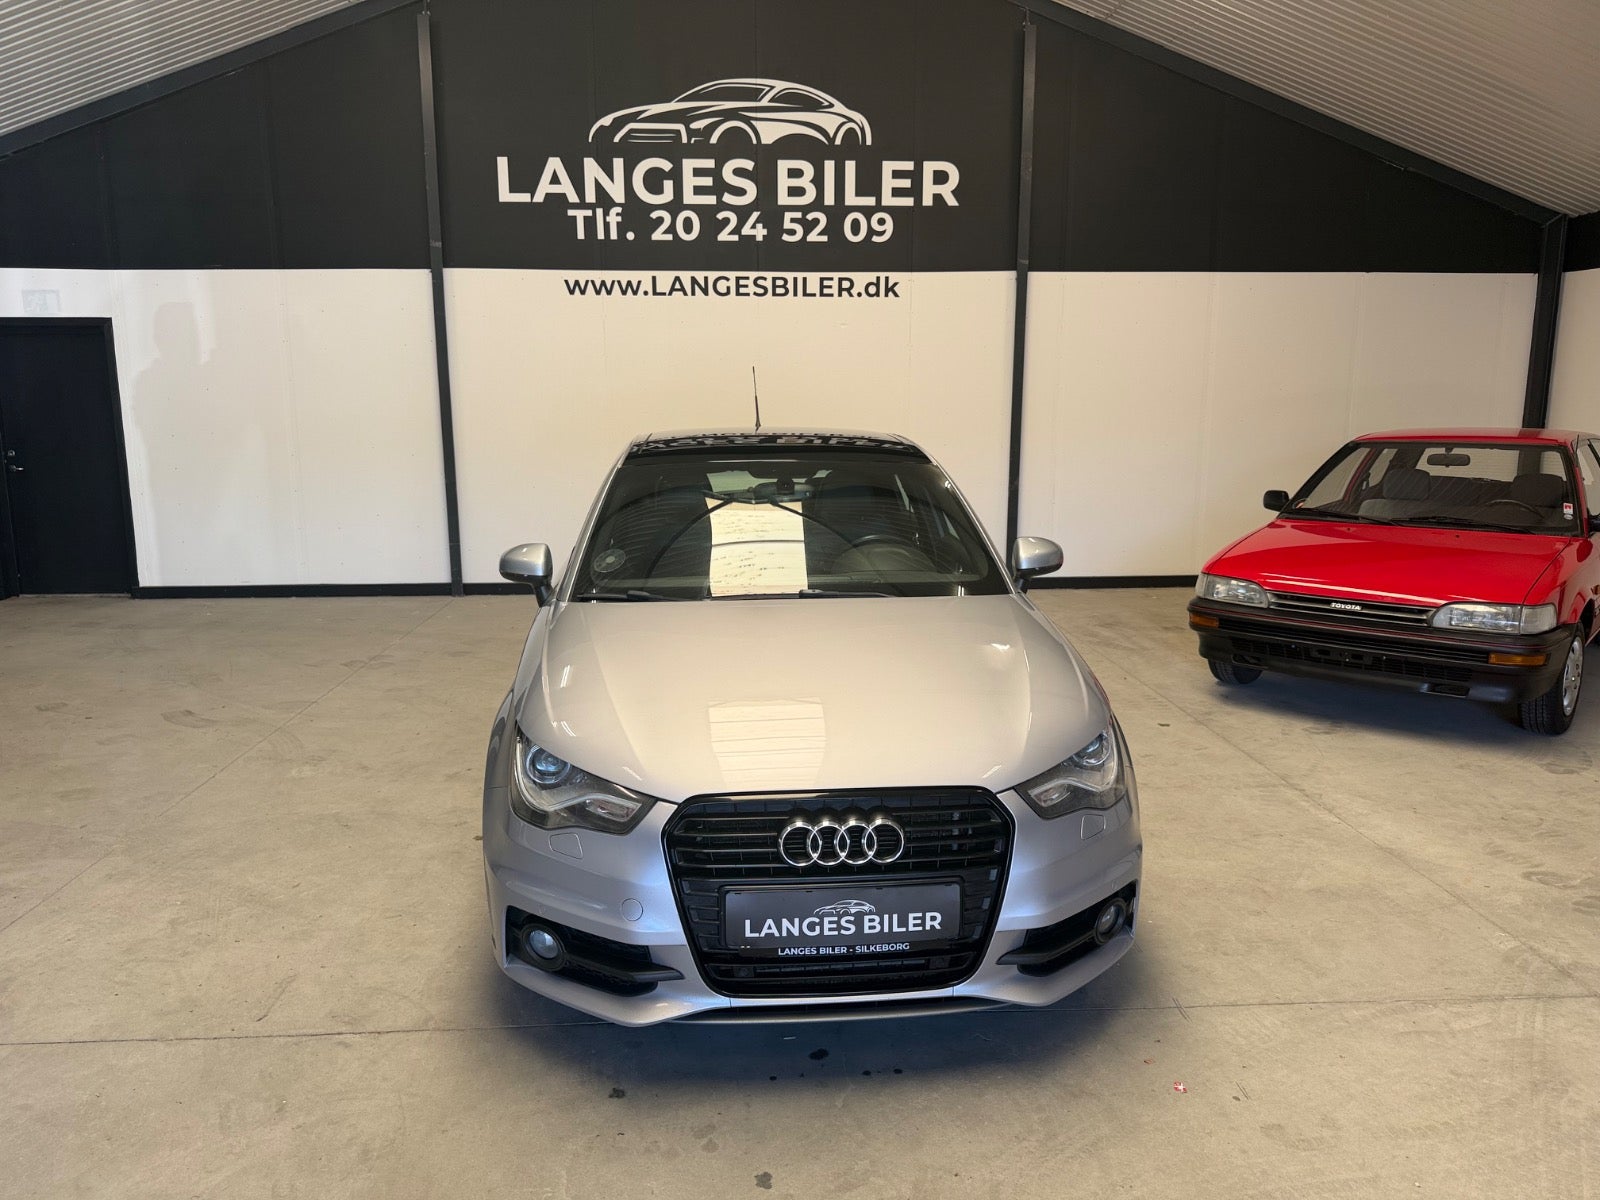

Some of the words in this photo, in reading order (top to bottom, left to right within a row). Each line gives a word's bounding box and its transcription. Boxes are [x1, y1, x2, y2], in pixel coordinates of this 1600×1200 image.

[496, 156, 758, 205] LANGES
[776, 159, 960, 207] BILER
[567, 206, 635, 240] Tlf.
[649, 209, 701, 241] 20
[716, 211, 768, 241] 24
[781, 211, 828, 242] 52
[843, 211, 894, 243] 09
[564, 275, 900, 298] www.LANGESBILER.dk
[1331, 602, 1361, 610] TOYOTA
[744, 916, 856, 938] LANGES
[863, 911, 942, 934] BILER
[778, 947, 817, 956] LANGES
[819, 946, 848, 955] BILER
[855, 942, 910, 953] SILKEBORG
